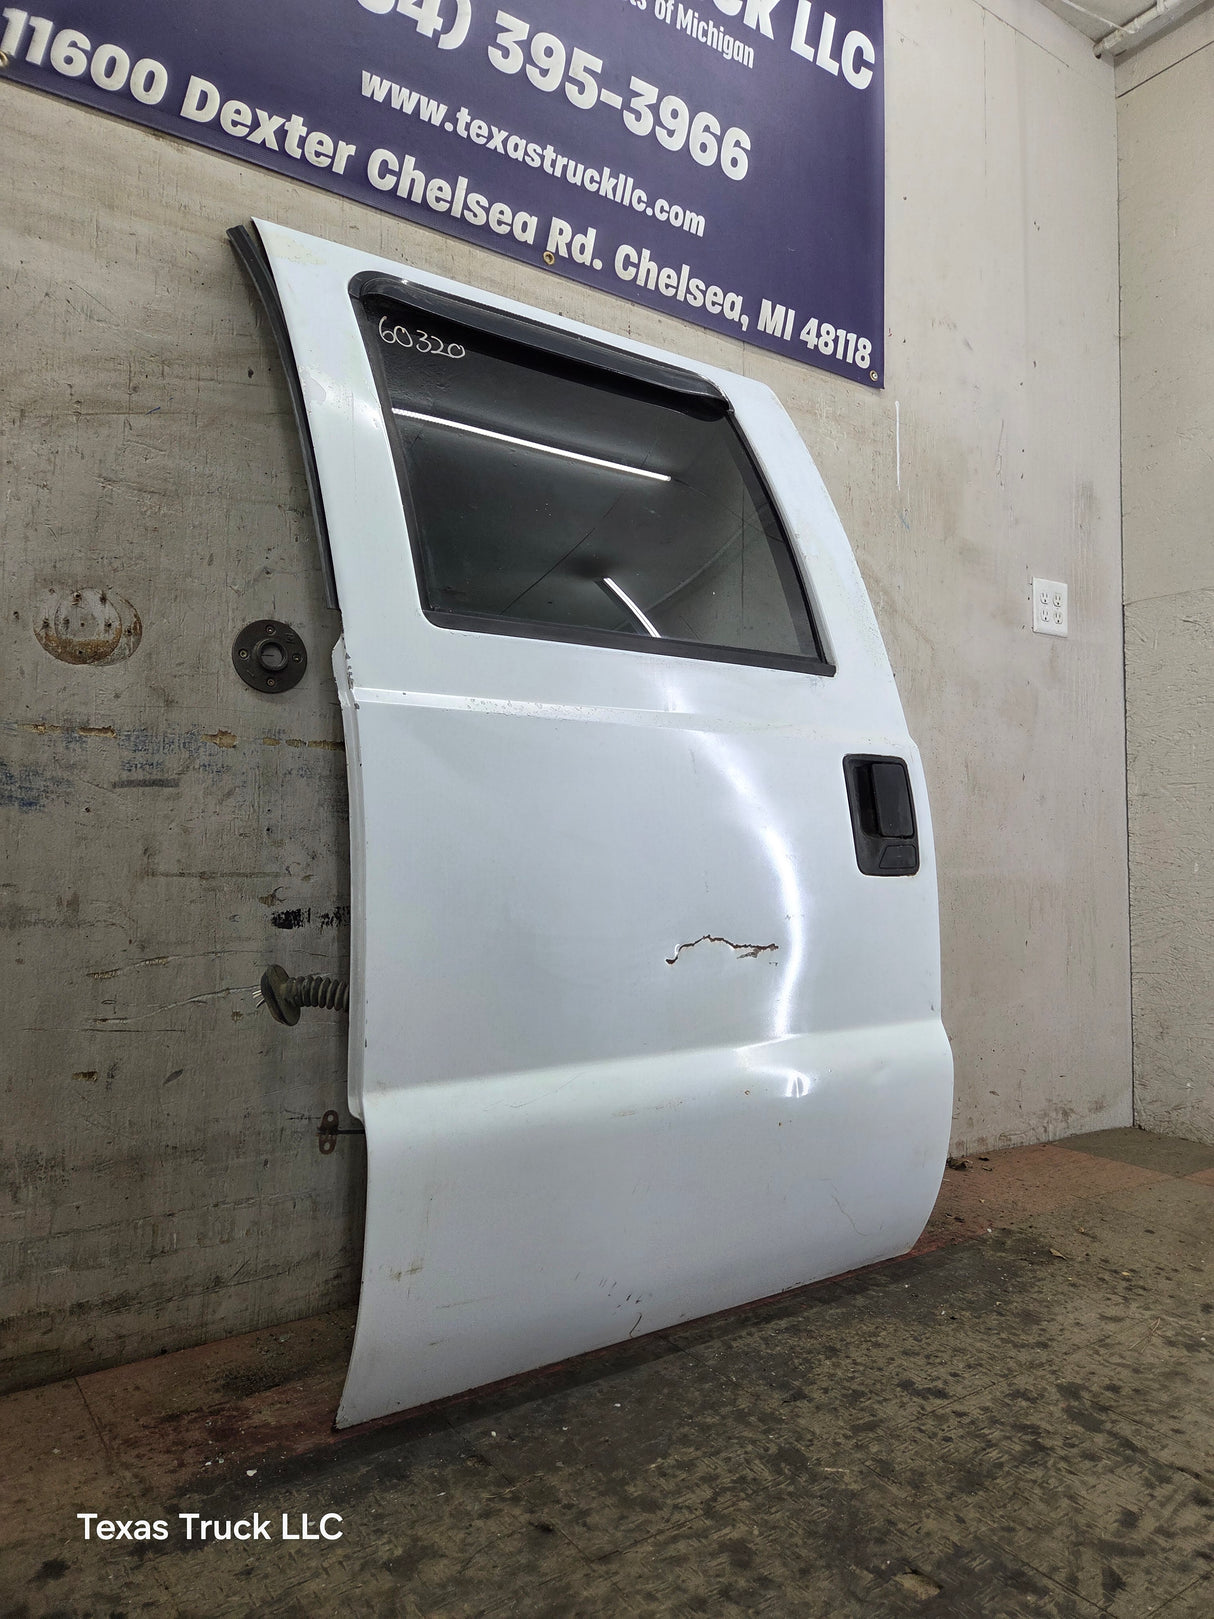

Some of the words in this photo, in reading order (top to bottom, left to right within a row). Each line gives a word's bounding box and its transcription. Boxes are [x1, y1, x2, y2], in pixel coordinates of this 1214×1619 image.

[357, 0, 472, 50] 4)
[487, 10, 752, 181] 395-3966
[654, 0, 675, 25] of
[676, 2, 755, 69] Michigan
[790, 0, 876, 90] LLC
[0, 7, 169, 105] 11600
[180, 75, 356, 175] Dexter
[367, 148, 539, 246] Chelsea
[546, 216, 603, 271] Rd.
[614, 244, 749, 332] Chelsea,
[757, 298, 796, 342] MI
[799, 317, 873, 369] 48118
[361, 70, 706, 238] www.texastruckllc.com
[378, 315, 466, 359] 60320
